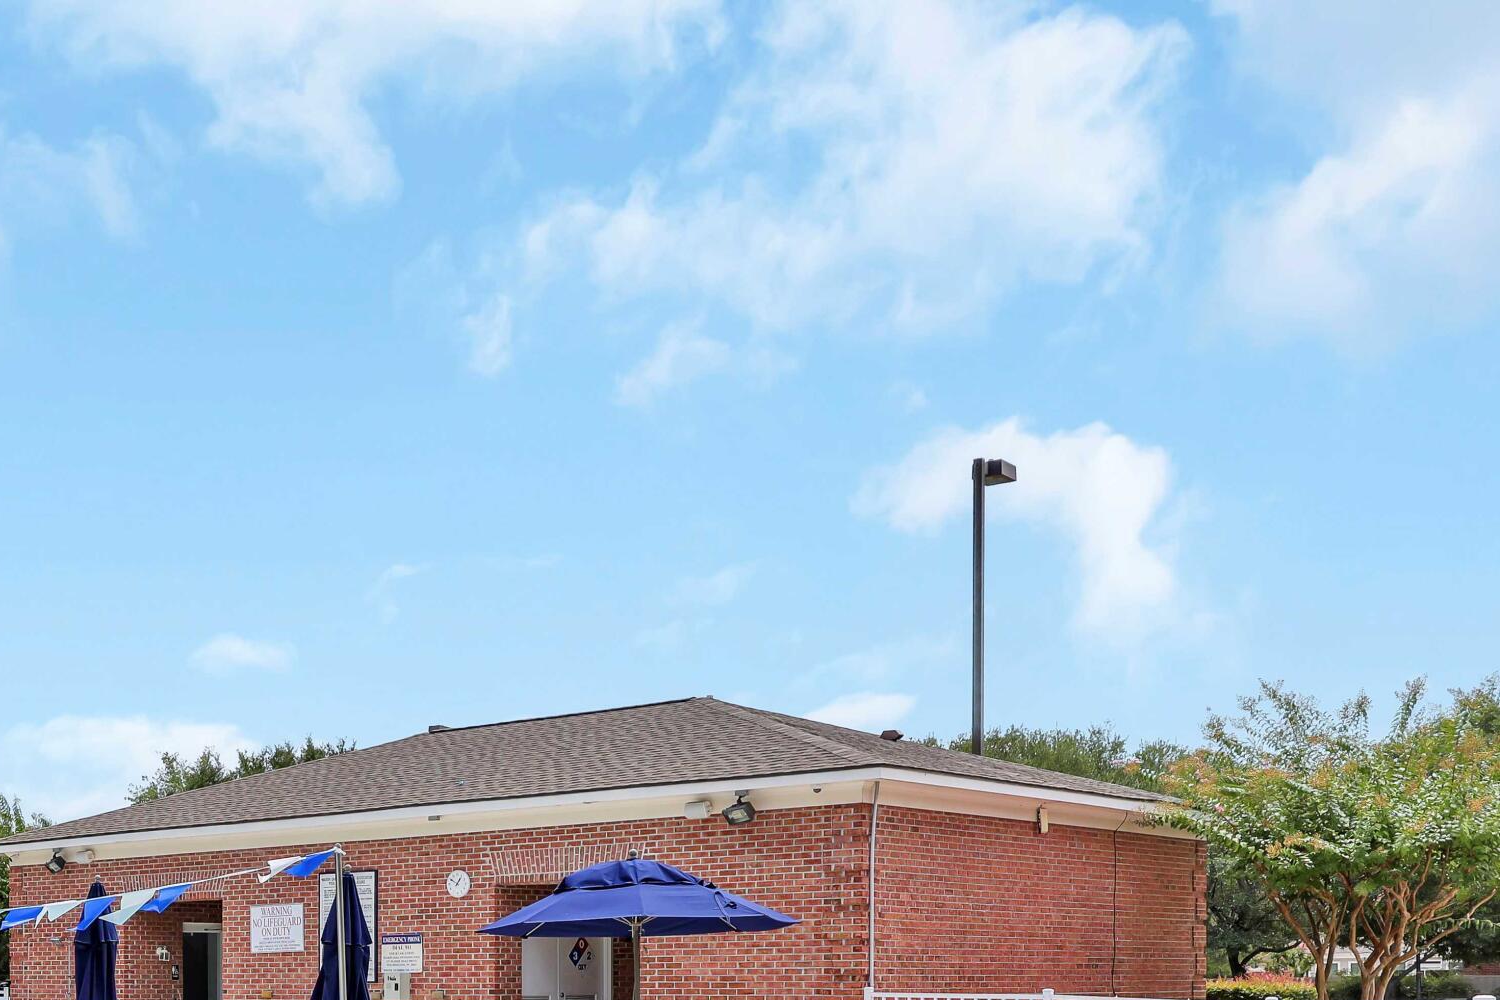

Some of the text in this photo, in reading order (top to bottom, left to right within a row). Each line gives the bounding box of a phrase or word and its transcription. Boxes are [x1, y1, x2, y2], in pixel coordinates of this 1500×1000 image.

[260, 906, 292, 916] WARNING
[252, 917, 302, 928] NO LIFEGUARD
[261, 926, 291, 936] ON DUTY
[579, 940, 585, 949] 0
[572, 951, 592, 960] 3 2
